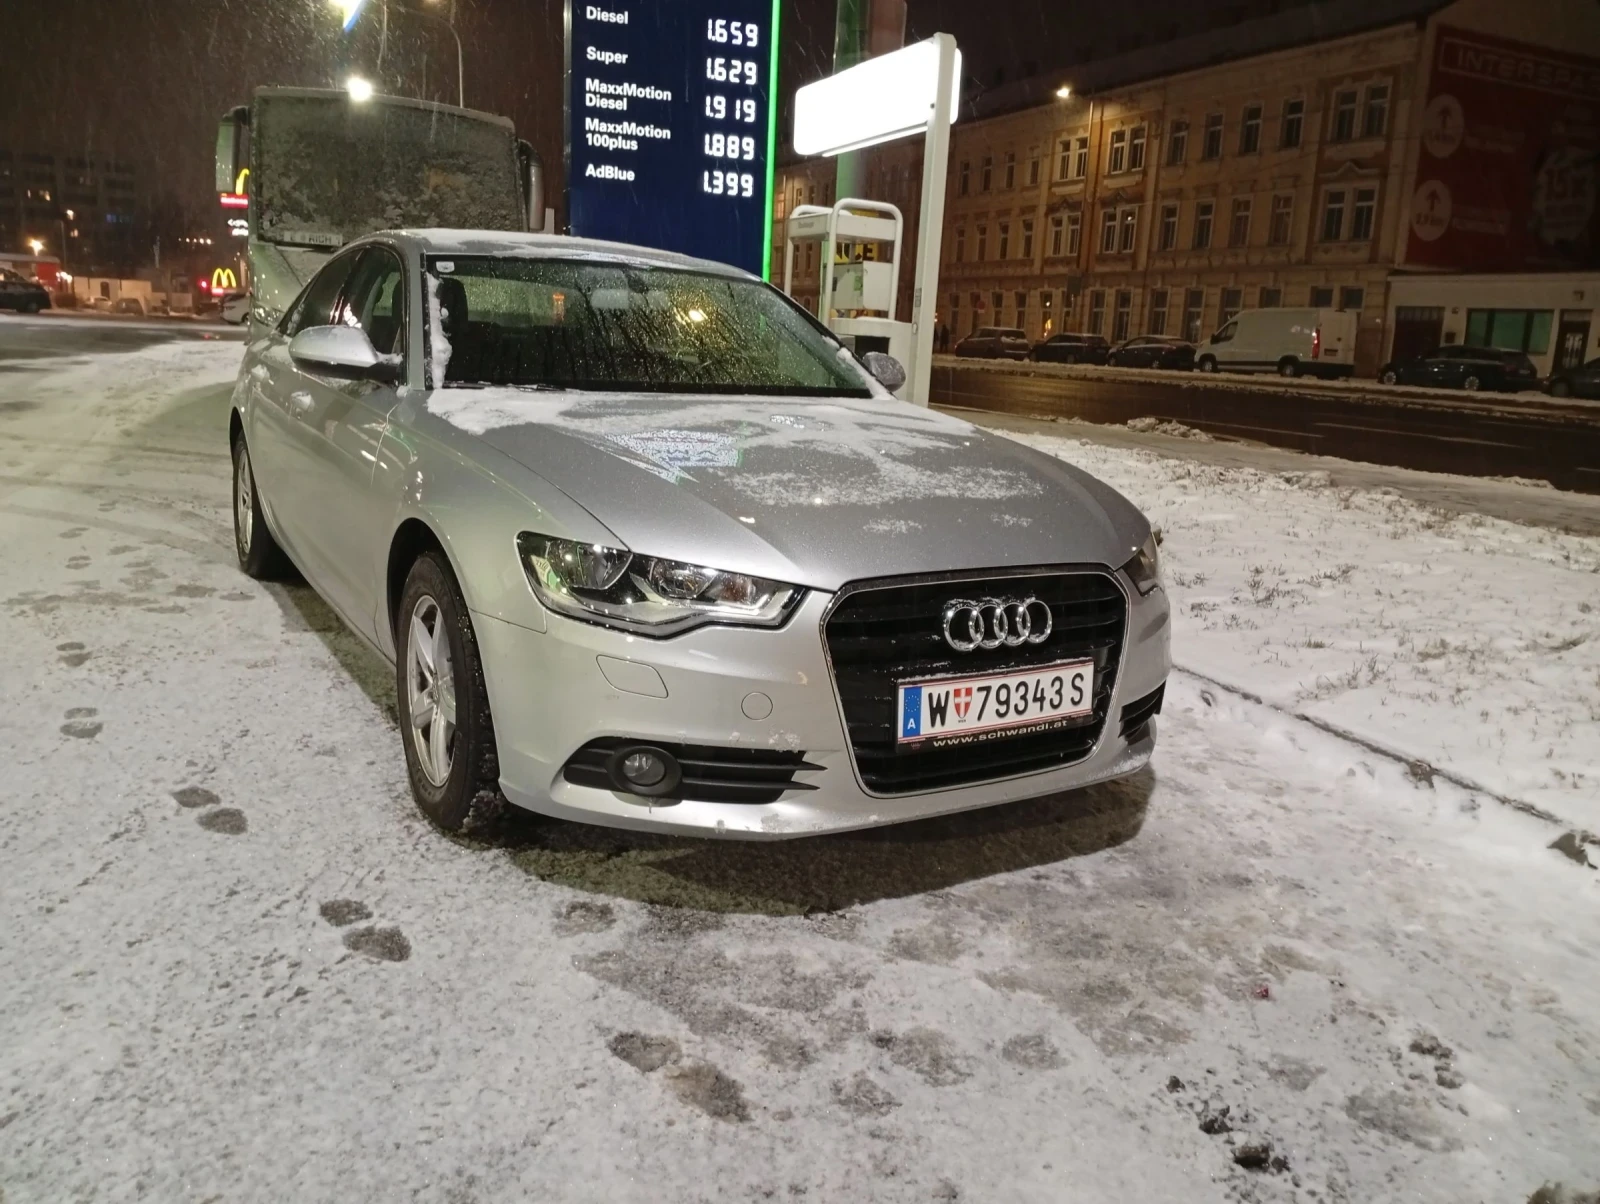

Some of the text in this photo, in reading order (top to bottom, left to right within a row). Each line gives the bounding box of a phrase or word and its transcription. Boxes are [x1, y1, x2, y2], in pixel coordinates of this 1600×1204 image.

[586, 6, 628, 24] Diesel
[707, 18, 758, 47] 1.659
[586, 46, 628, 65] Super
[706, 57, 757, 85] 1.629
[585, 78, 672, 102] MaxxMotion
[585, 93, 627, 111] Diesel
[705, 95, 756, 123] 1.919
[585, 117, 671, 140] MaxxMotion
[585, 133, 638, 150] 100plus
[704, 134, 755, 160] 1.889
[585, 163, 635, 181] AdBlue
[703, 170, 753, 197] 1.399
[928, 690, 950, 728] W
[907, 718, 916, 729] A
[933, 719, 1068, 747] www.schwandl.at
